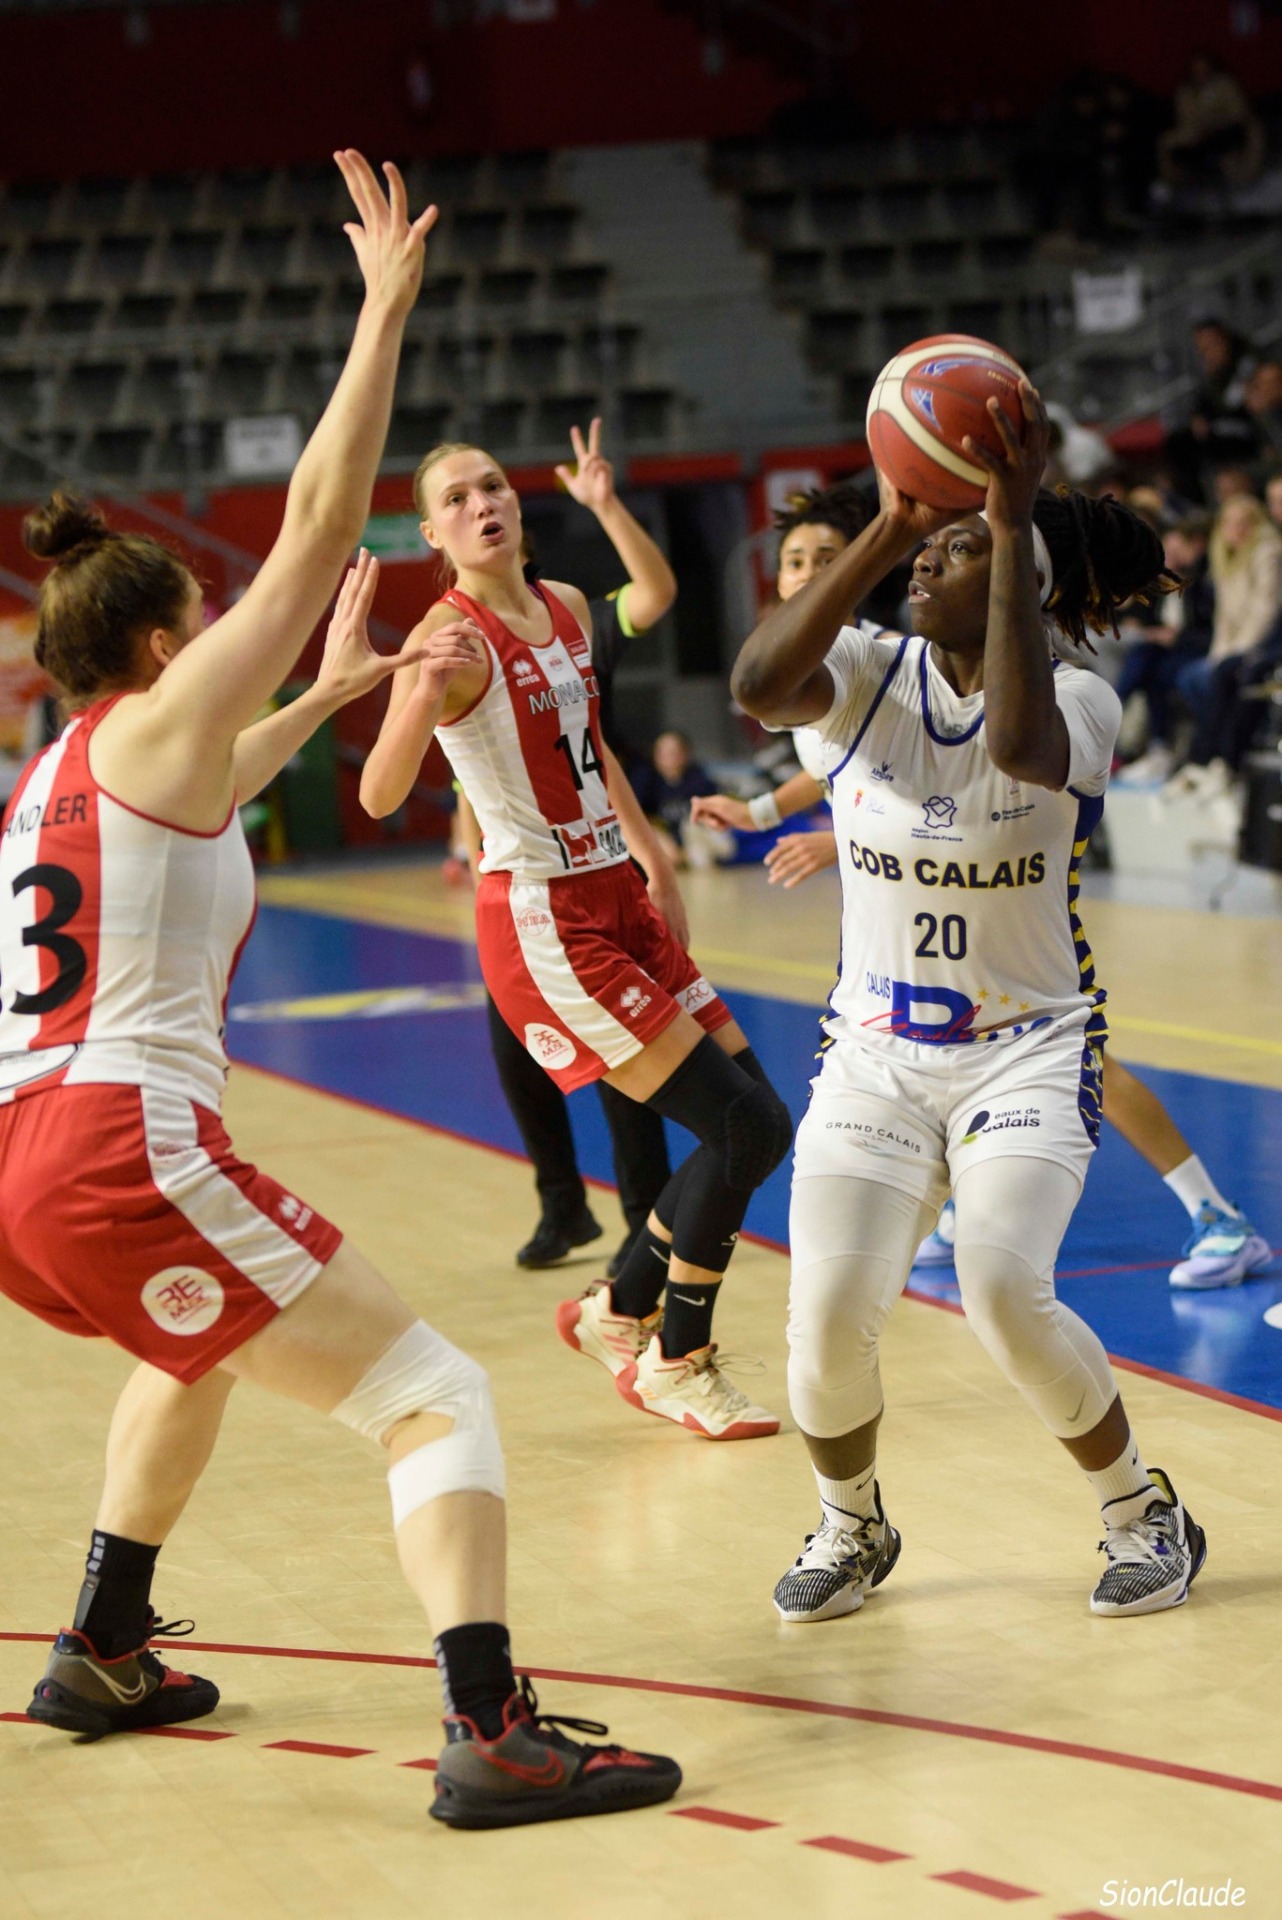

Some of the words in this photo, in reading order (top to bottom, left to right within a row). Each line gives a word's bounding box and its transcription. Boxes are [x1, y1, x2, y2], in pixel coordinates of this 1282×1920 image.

[554, 727, 604, 791] 14
[849, 839, 904, 883] COB
[914, 851, 1046, 889] CALAIS
[0, 863, 88, 1016] 3
[914, 911, 968, 961] 20
[866, 970, 891, 1000] CALAIS
[825, 1121, 873, 1133] GRAND
[877, 1128, 921, 1153] CALAIS
[994, 1109, 1022, 1120] eaux
[1025, 1107, 1041, 1115] de
